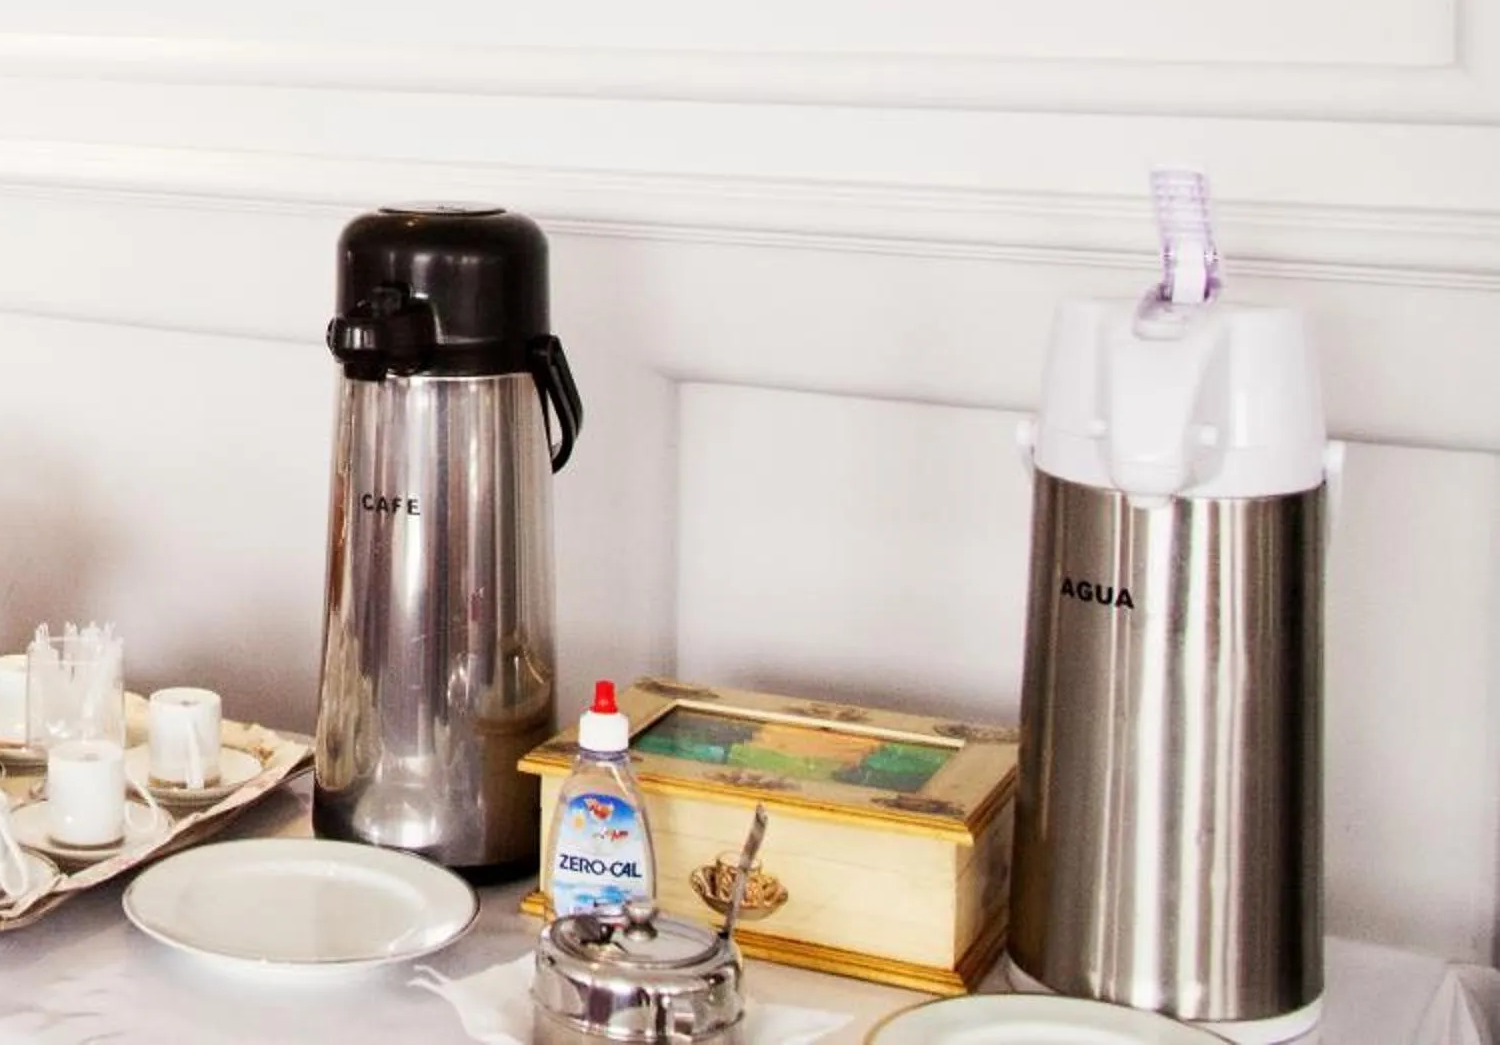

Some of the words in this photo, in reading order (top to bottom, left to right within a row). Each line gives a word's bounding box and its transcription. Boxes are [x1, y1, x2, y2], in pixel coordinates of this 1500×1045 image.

[362, 493, 420, 515] CAFE
[1061, 577, 1134, 609] AGUA
[559, 854, 642, 878] ZERO-CAL
